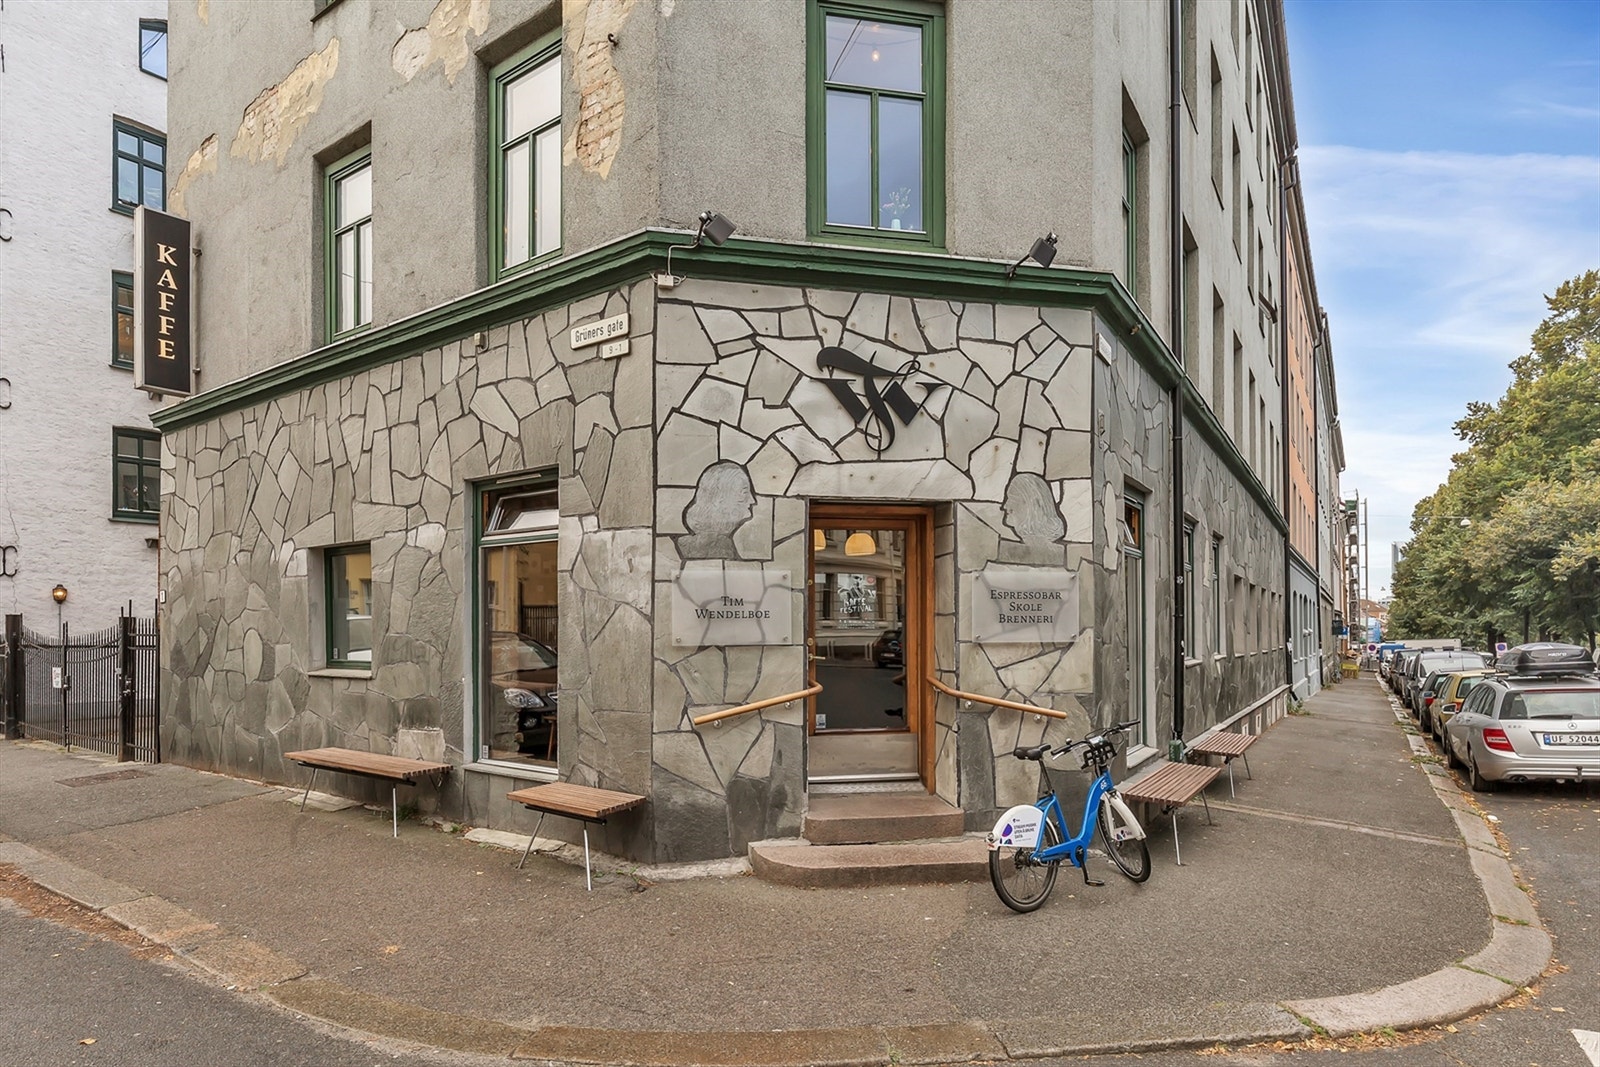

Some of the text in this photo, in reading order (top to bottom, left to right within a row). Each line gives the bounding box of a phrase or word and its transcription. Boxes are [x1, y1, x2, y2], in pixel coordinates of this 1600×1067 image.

[157, 243, 178, 360] KAFFE
[575, 320, 623, 342] Grüners gate
[840, 605, 872, 614] FESTIVAL
[1009, 601, 1043, 612] SKOLE
[998, 613, 1053, 624] BRENNERI
[1551, 735, 1599, 743] UF 52044
